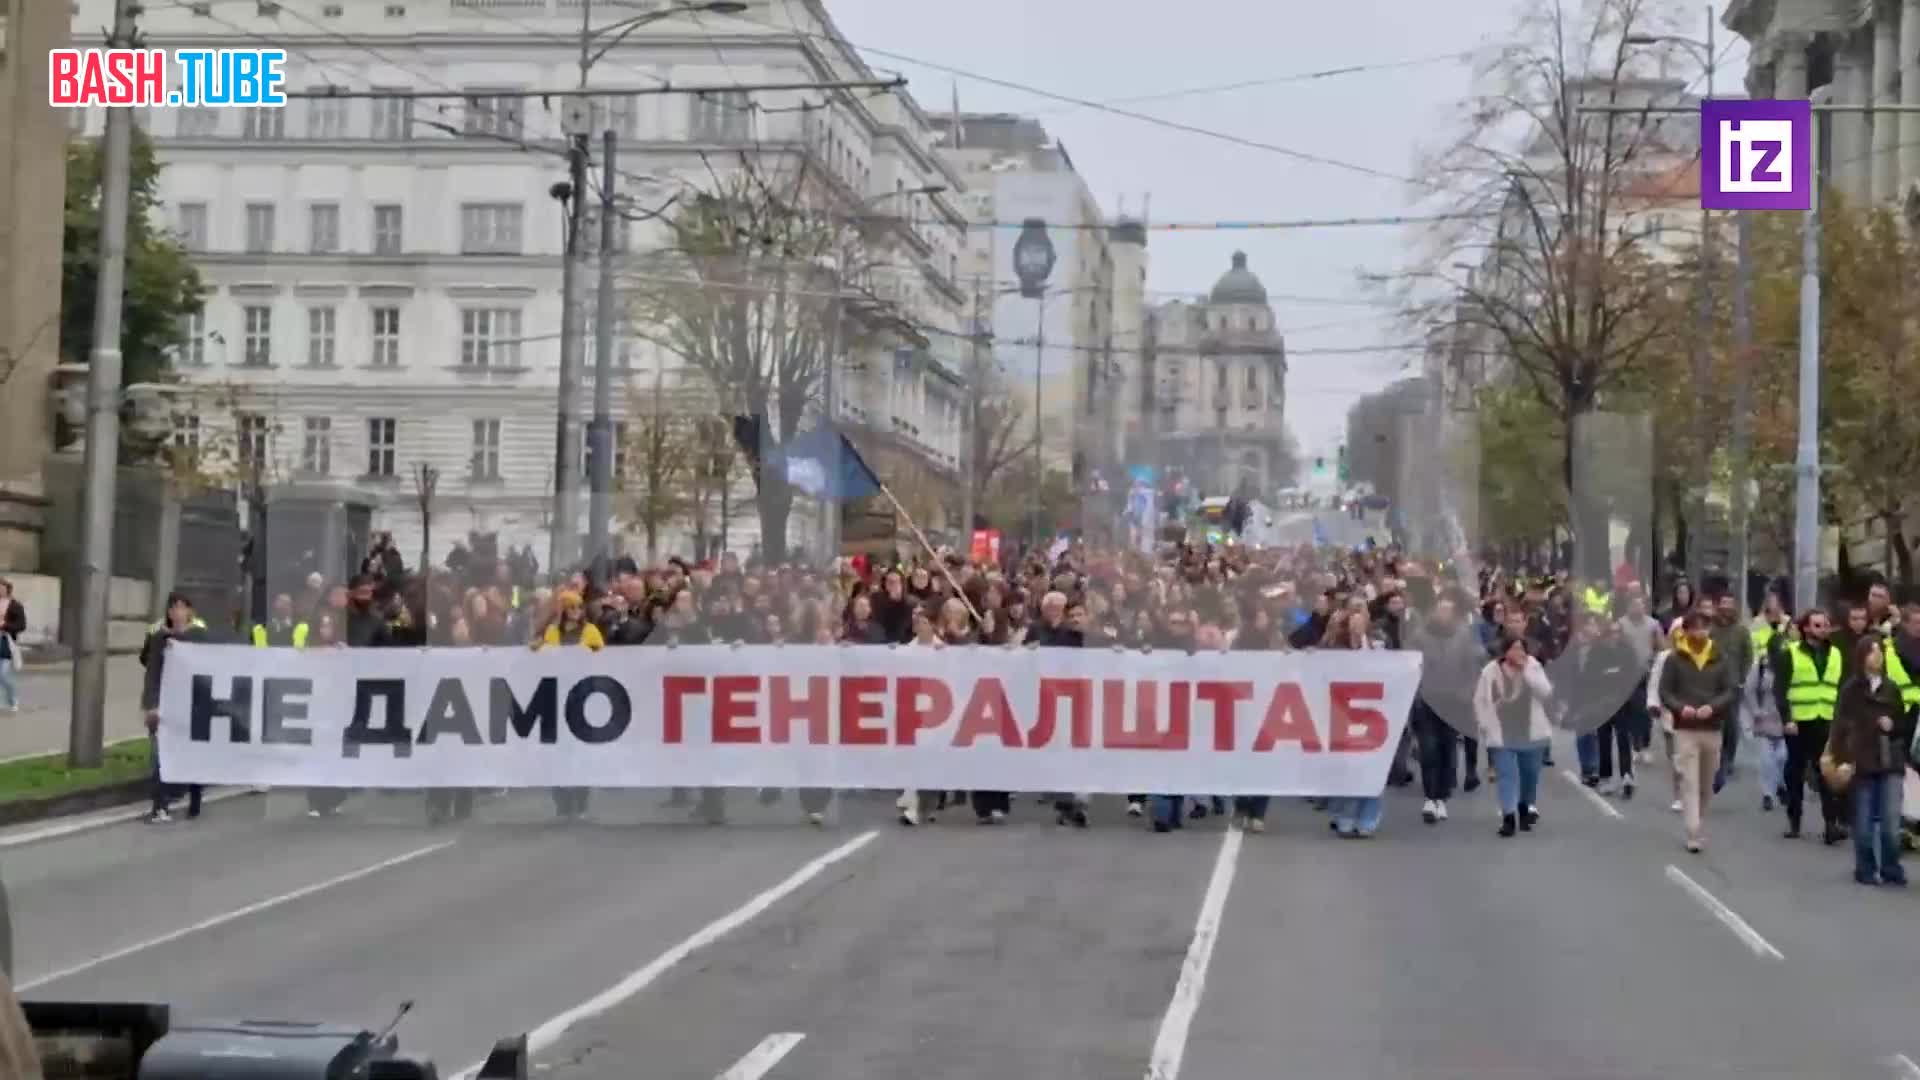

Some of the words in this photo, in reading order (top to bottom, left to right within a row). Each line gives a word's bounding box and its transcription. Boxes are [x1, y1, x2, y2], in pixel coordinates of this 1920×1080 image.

[189, 674, 312, 745] НЕ
[341, 675, 633, 759] ДАМО
[662, 675, 1388, 754] ГЕНЕРАЛШТАБ
